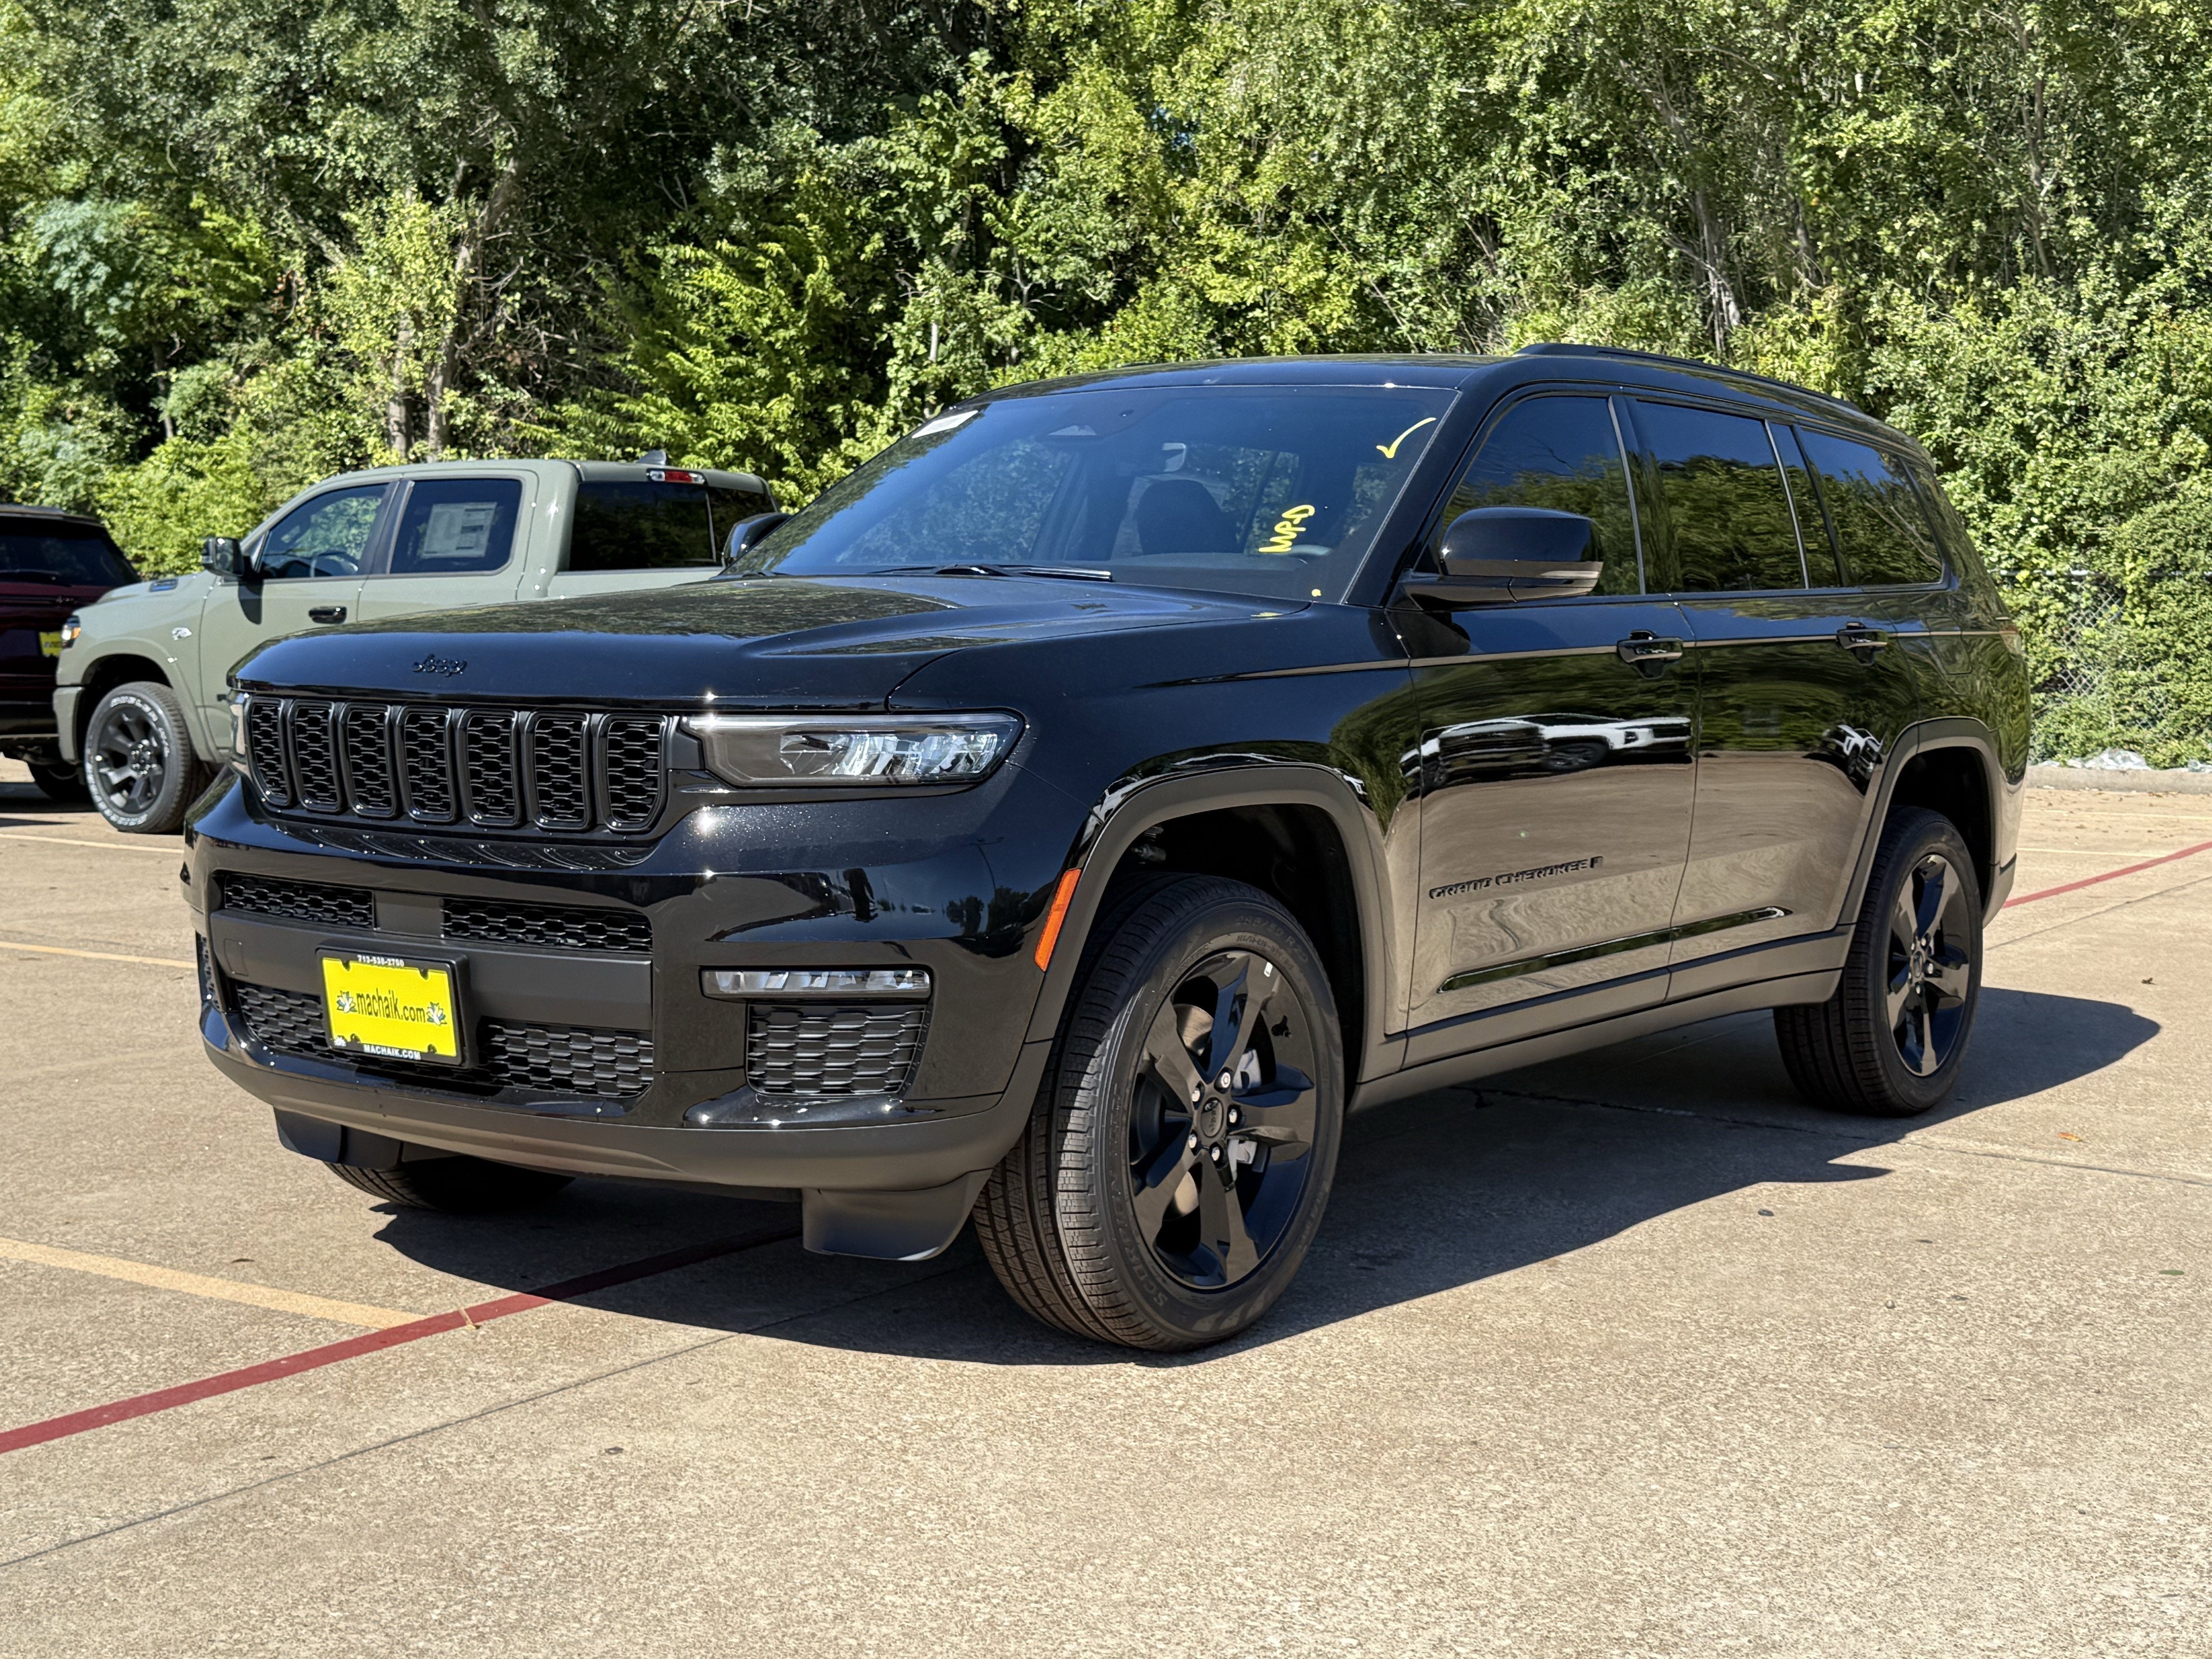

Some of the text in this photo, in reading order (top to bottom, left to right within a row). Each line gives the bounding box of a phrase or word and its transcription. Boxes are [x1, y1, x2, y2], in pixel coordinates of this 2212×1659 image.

[413, 653, 467, 677] Jeep
[1429, 877, 1492, 899] GRAND
[1496, 859, 1588, 886] CHEROKEE
[356, 988, 426, 1023] machaik.com
[363, 1044, 421, 1060] MACHAIK.COM
